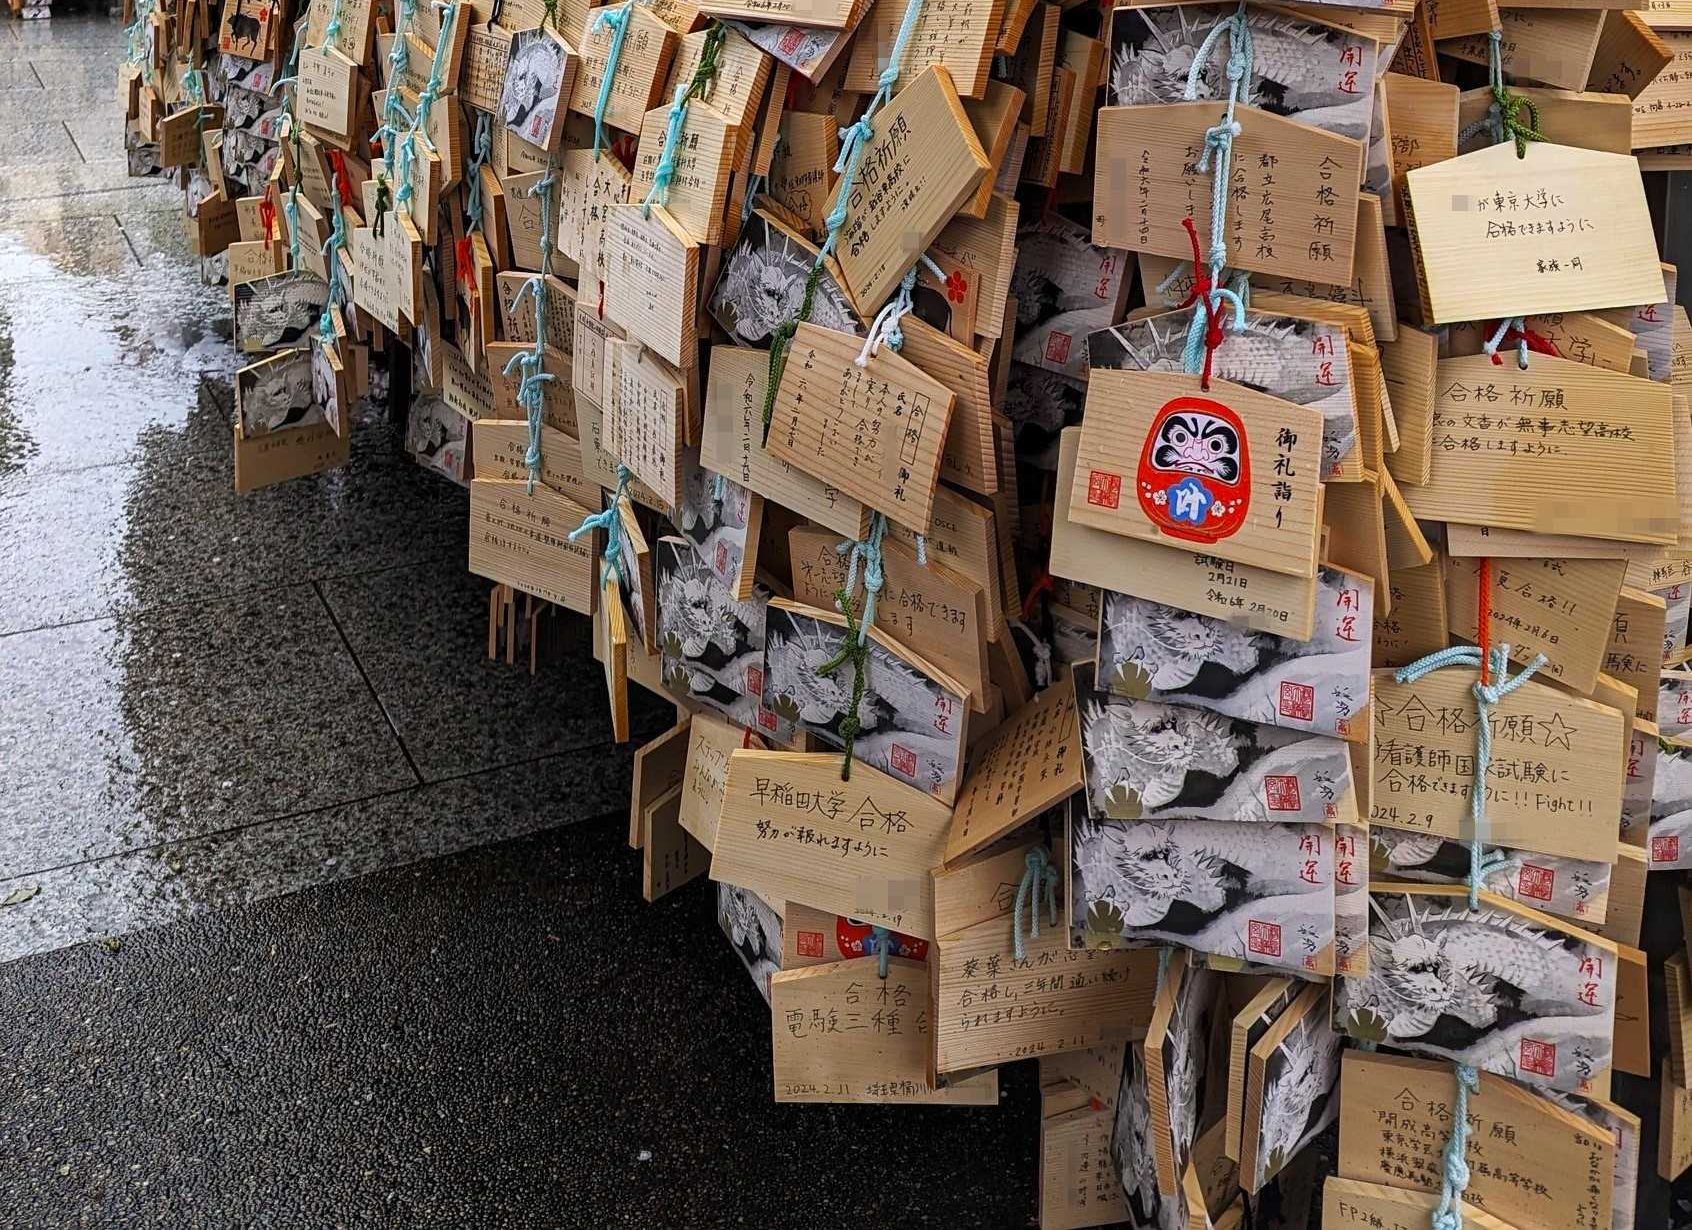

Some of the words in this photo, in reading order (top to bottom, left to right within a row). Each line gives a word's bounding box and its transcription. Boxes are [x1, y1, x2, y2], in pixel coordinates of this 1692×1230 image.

[1337, 45, 1367, 95] 開運
[657, 129, 699, 149] 合祈願
[1231, 153, 1250, 253] に合格します
[1256, 153, 1280, 261] 都立広尾高校
[1308, 154, 1343, 262] 合格祈願
[1477, 188, 1566, 214] が東京大学に
[1485, 217, 1598, 241] 合格できますように
[1093, 255, 1118, 300] 開運
[1535, 256, 1585, 275] 家族一同
[1311, 334, 1345, 387] 開運
[1440, 381, 1570, 412] 合格祈願
[893, 467, 910, 503] 御礼
[1270, 427, 1298, 530] 御礼詣り
[1205, 588, 1246, 609] 令和6年
[1207, 571, 1248, 589] 2月21日
[1335, 588, 1361, 642] 開運
[934, 696, 953, 737] 開運
[749, 776, 847, 821] 早稲田大学
[846, 795, 916, 835] 合格
[1535, 792, 1594, 818] Fight!!
[1298, 834, 1325, 885] 開運
[1335, 834, 1360, 886] 開運
[844, 981, 912, 1008] 合格
[1577, 956, 1605, 1008] 開運
[784, 1006, 904, 1040] 電験三種
